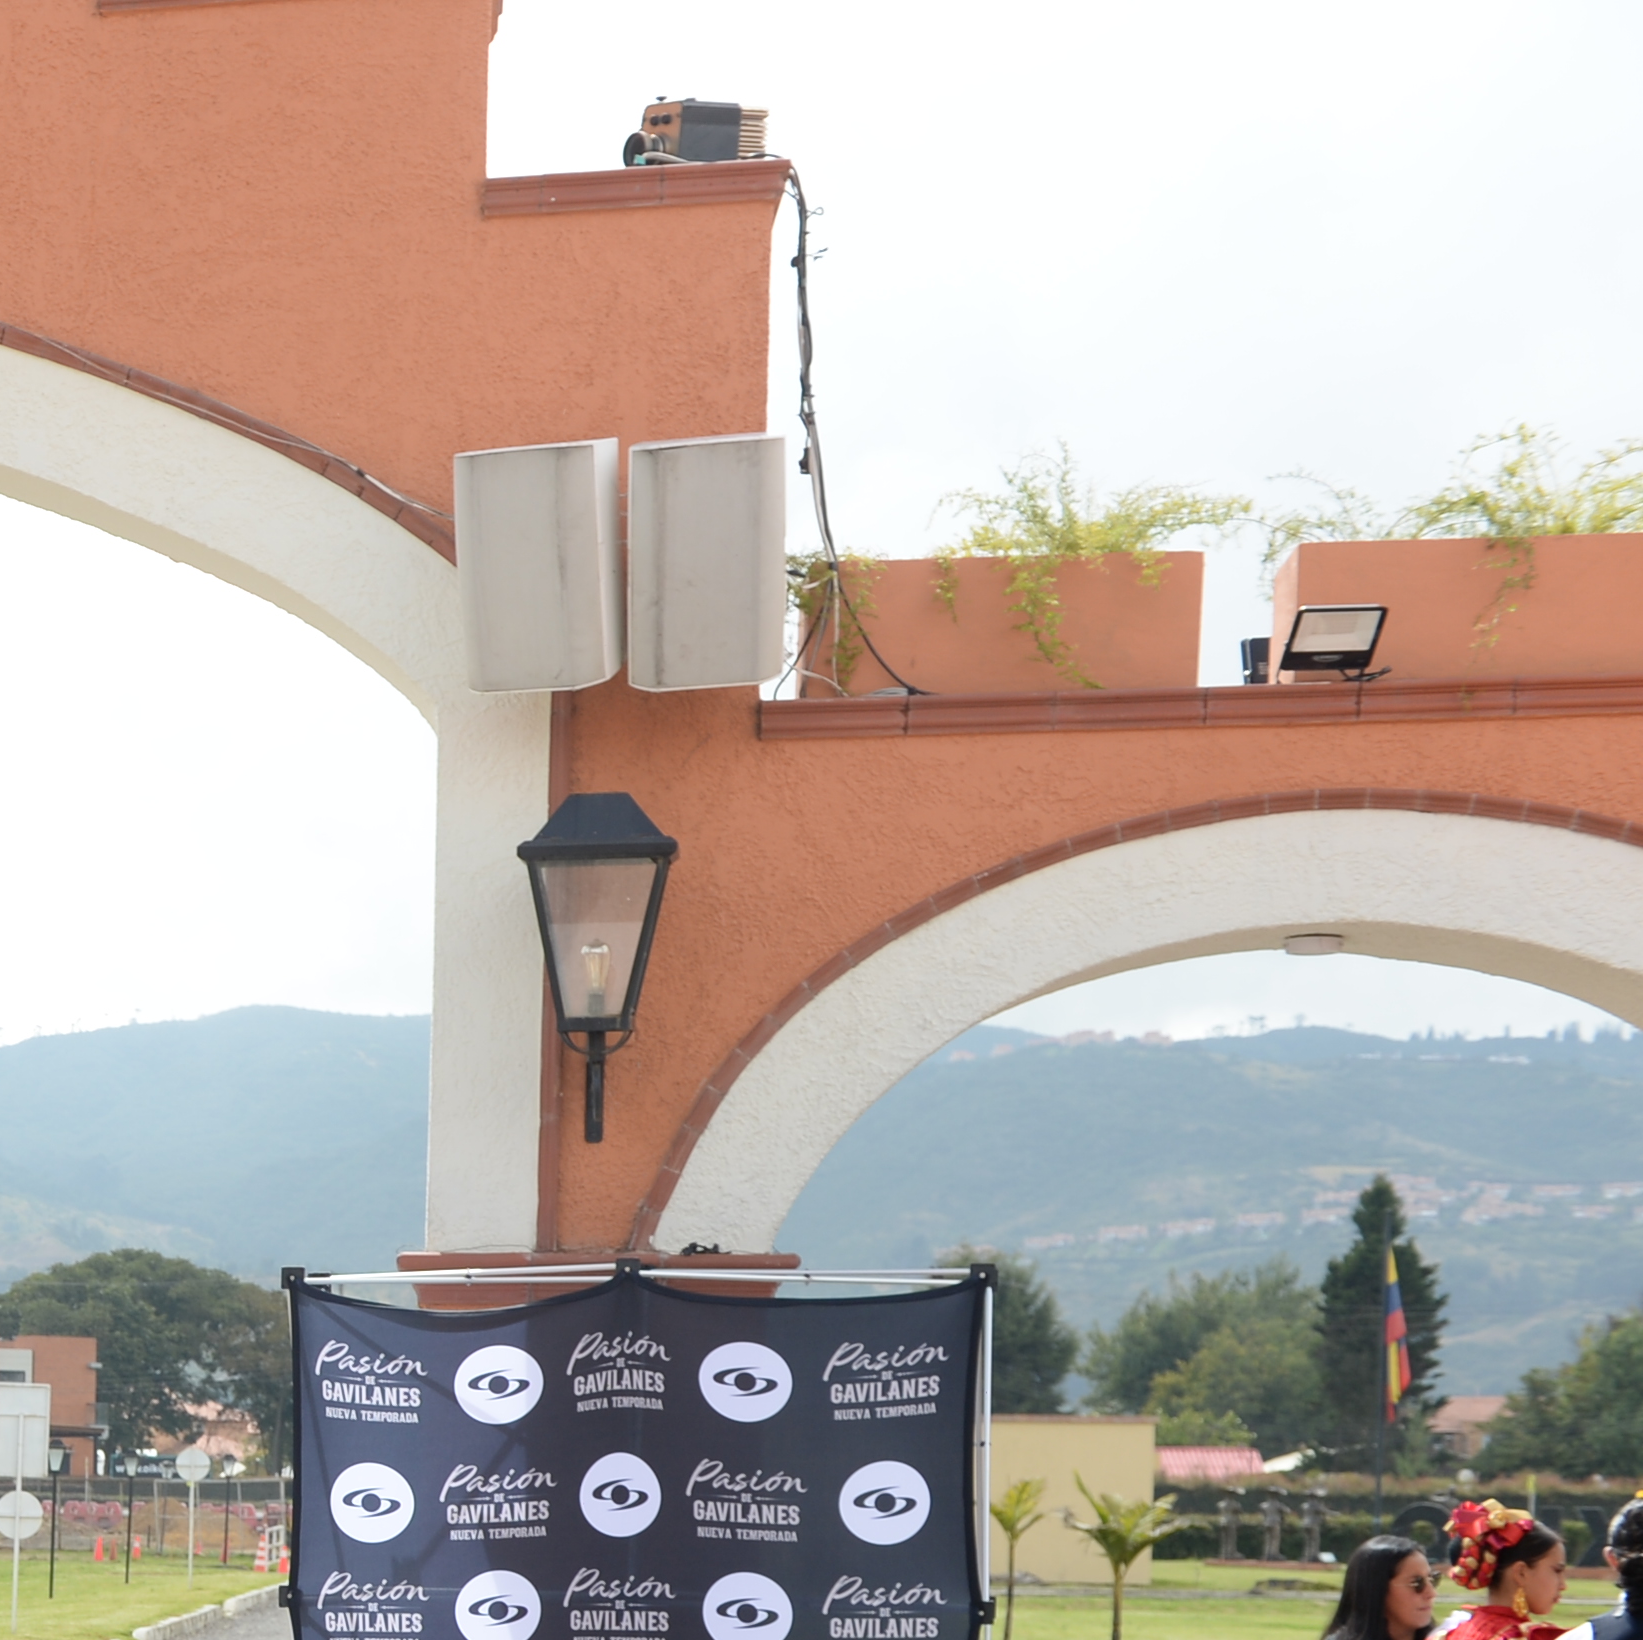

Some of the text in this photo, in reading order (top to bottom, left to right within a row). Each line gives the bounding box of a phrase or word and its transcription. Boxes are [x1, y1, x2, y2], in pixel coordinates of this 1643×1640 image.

[315, 1340, 427, 1376] Pasión
[567, 1331, 670, 1375] Pasión
[823, 1342, 948, 1381] Pasión
[322, 1379, 420, 1407] GAVILANES
[574, 1369, 664, 1396] GAVILANES
[831, 1376, 940, 1404] GAVILANES
[326, 1407, 418, 1423] NUEVA TEMPORADA
[577, 1397, 663, 1412] NUEVA TEMPORADA
[834, 1402, 936, 1420] NUEVA TEMPORADA
[439, 1464, 556, 1502] Pasión
[686, 1458, 807, 1496] Pasión
[447, 1500, 549, 1524] GAVILANES
[693, 1500, 799, 1525] GAVILANES
[451, 1526, 546, 1540] NUEVA TEMPORADA
[697, 1526, 797, 1542] NUEVA TEMPORADA
[317, 1571, 429, 1609] Pasión
[563, 1568, 675, 1607] Pasión
[823, 1576, 947, 1614] Pasión
[325, 1612, 422, 1632] GAVILANES
[571, 1610, 669, 1631] GAVILANES
[830, 1618, 939, 1638] GAVILANES
